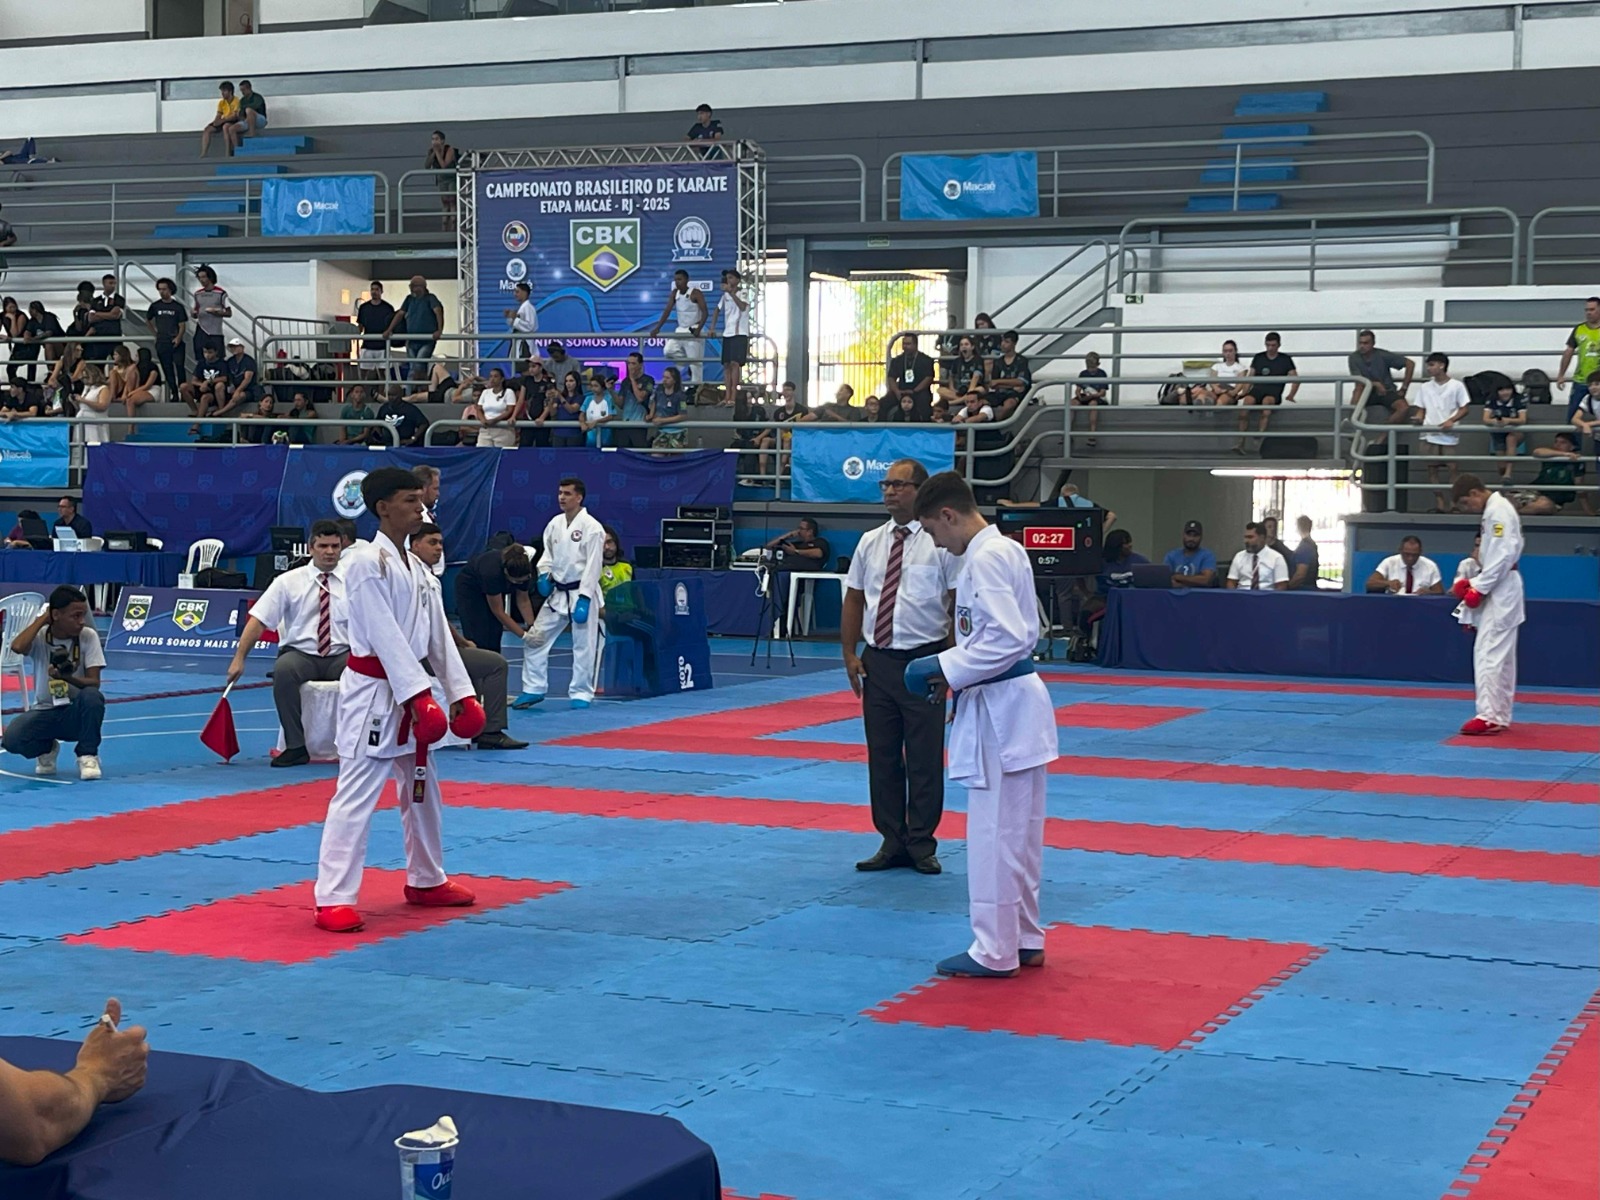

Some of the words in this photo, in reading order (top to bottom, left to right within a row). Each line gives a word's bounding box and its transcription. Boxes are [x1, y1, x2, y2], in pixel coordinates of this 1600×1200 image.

[486, 181, 572, 198] CAMPEONATO
[575, 178, 653, 196] BRASILEIRO
[657, 178, 674, 193] DE
[678, 176, 728, 193] KARATE
[540, 200, 572, 213] ETAPA
[575, 195, 612, 212] MACAÉ
[622, 198, 633, 215] RJ
[643, 197, 670, 210] 2025
[576, 225, 634, 245] CBK
[499, 279, 533, 290] Macé
[566, 338, 608, 347] SOMOS
[610, 338, 639, 347] MAIS
[866, 459, 894, 471] Mac
[1032, 533, 1065, 544] 02:27
[178, 602, 205, 612] CBK
[126, 636, 164, 646] JUNTOS
[166, 637, 202, 648] SOMOS
[203, 639, 229, 649] MAIS
[231, 640, 271, 650] FES!
[684, 663, 695, 688] 2
